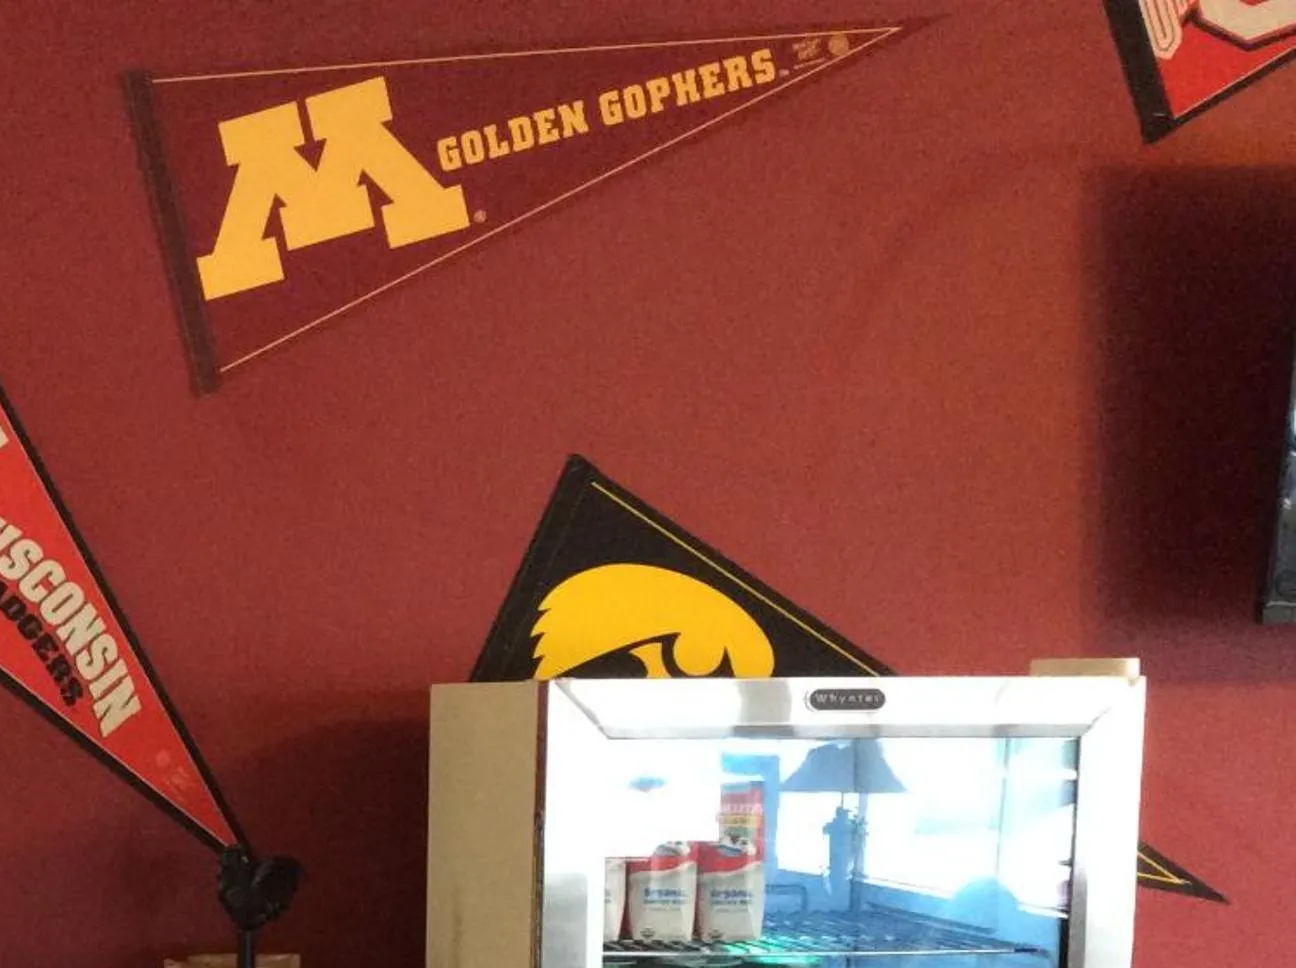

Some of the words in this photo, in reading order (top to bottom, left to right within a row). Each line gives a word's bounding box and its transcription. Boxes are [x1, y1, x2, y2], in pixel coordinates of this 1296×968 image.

[196, 76, 470, 301] M
[436, 100, 590, 172] GOLDEN
[598, 49, 777, 126] GOPHERS
